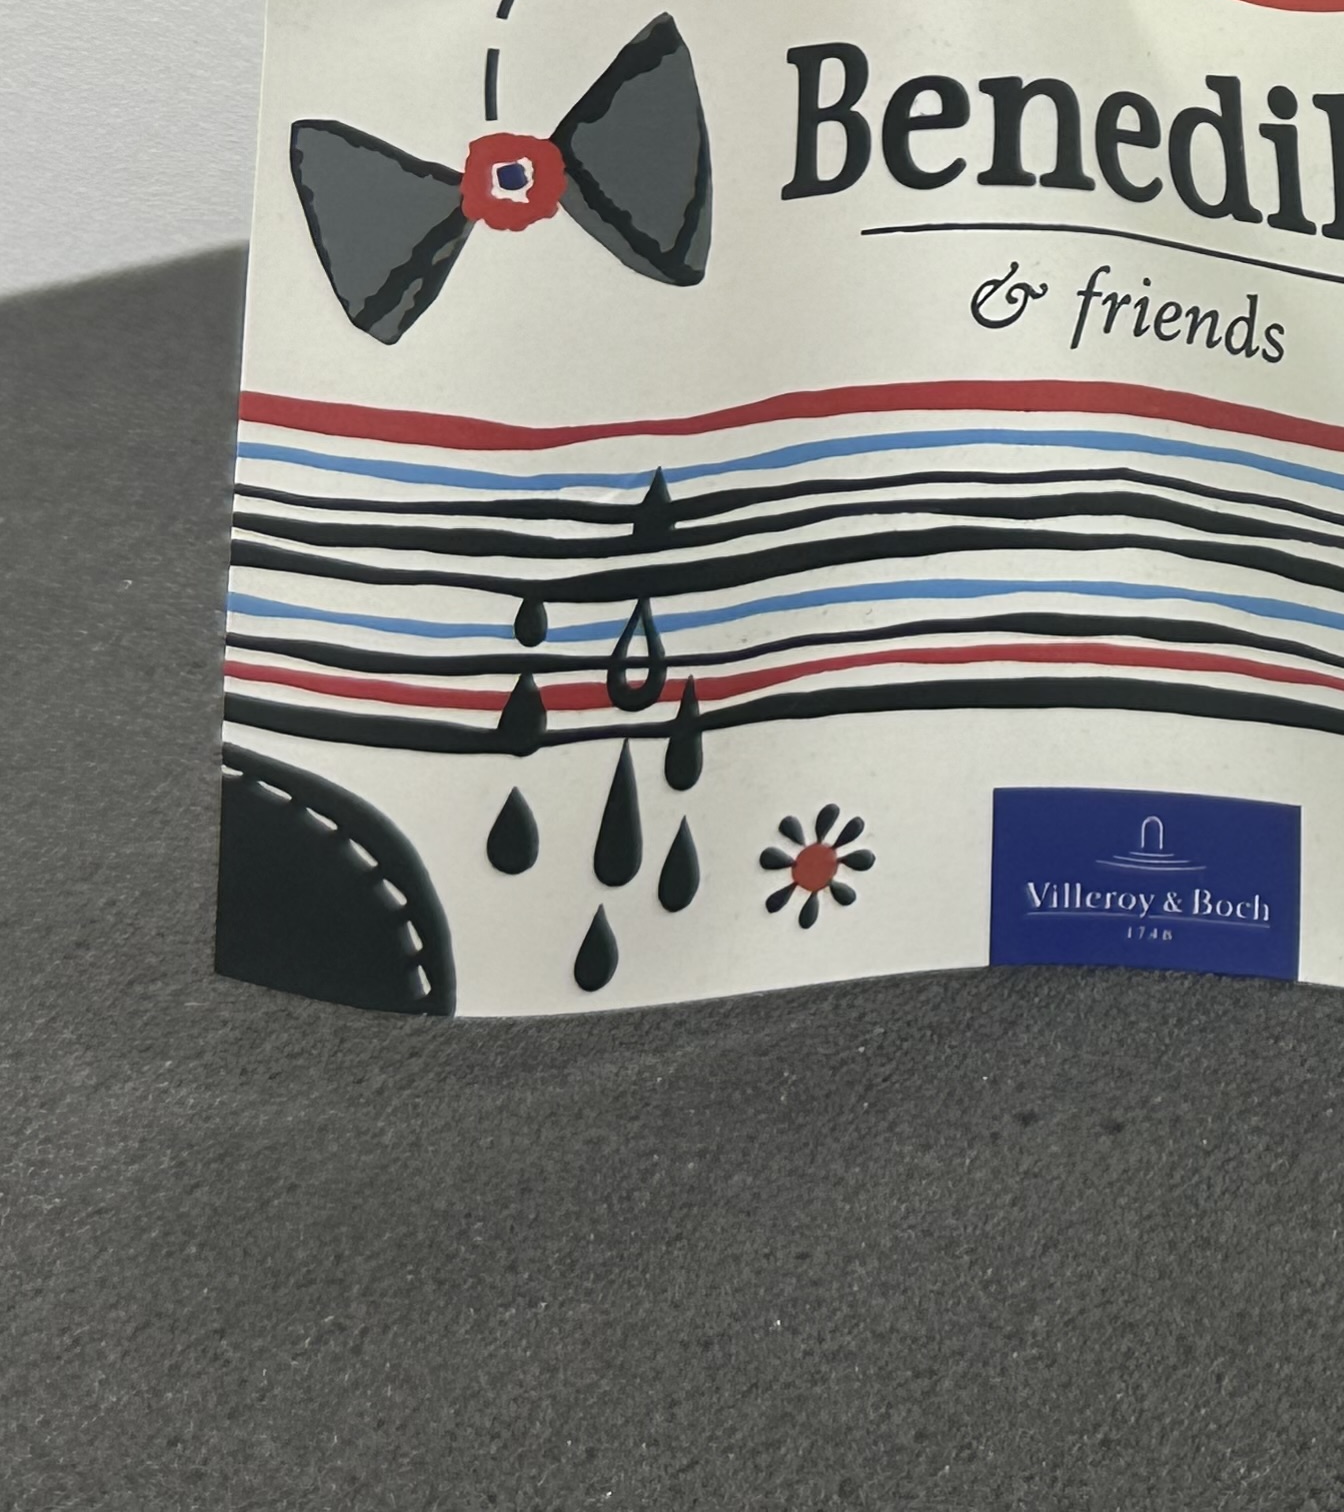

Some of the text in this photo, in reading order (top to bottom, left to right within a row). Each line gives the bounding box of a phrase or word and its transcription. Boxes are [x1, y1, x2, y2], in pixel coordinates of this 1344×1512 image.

[970, 261, 1286, 363] & friends
[1027, 881, 1270, 922] Villeroy & Boch
